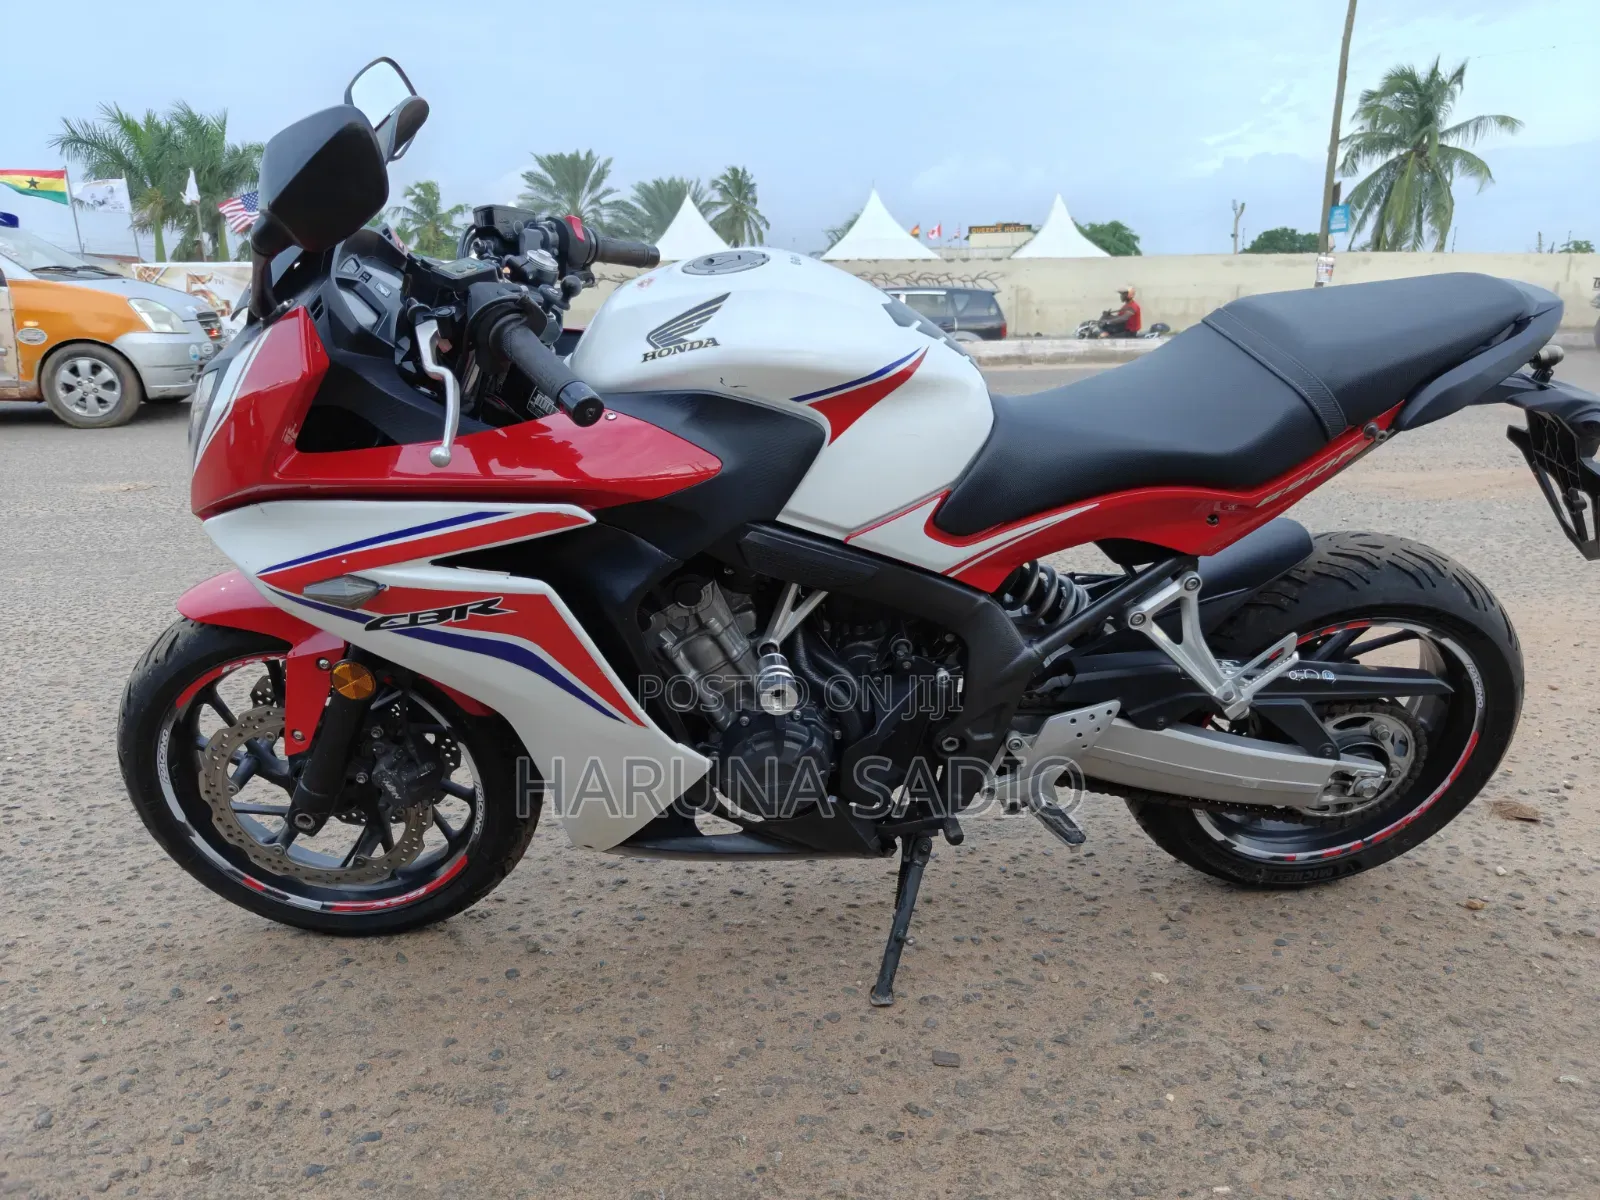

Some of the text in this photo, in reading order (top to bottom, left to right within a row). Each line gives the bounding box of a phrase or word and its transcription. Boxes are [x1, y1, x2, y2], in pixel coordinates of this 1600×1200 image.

[641, 337, 721, 363] HONDA
[364, 596, 518, 632] CBR
[1466, 663, 1484, 709] RACING
[158, 727, 171, 785] RACING
[473, 780, 485, 835] RACING
